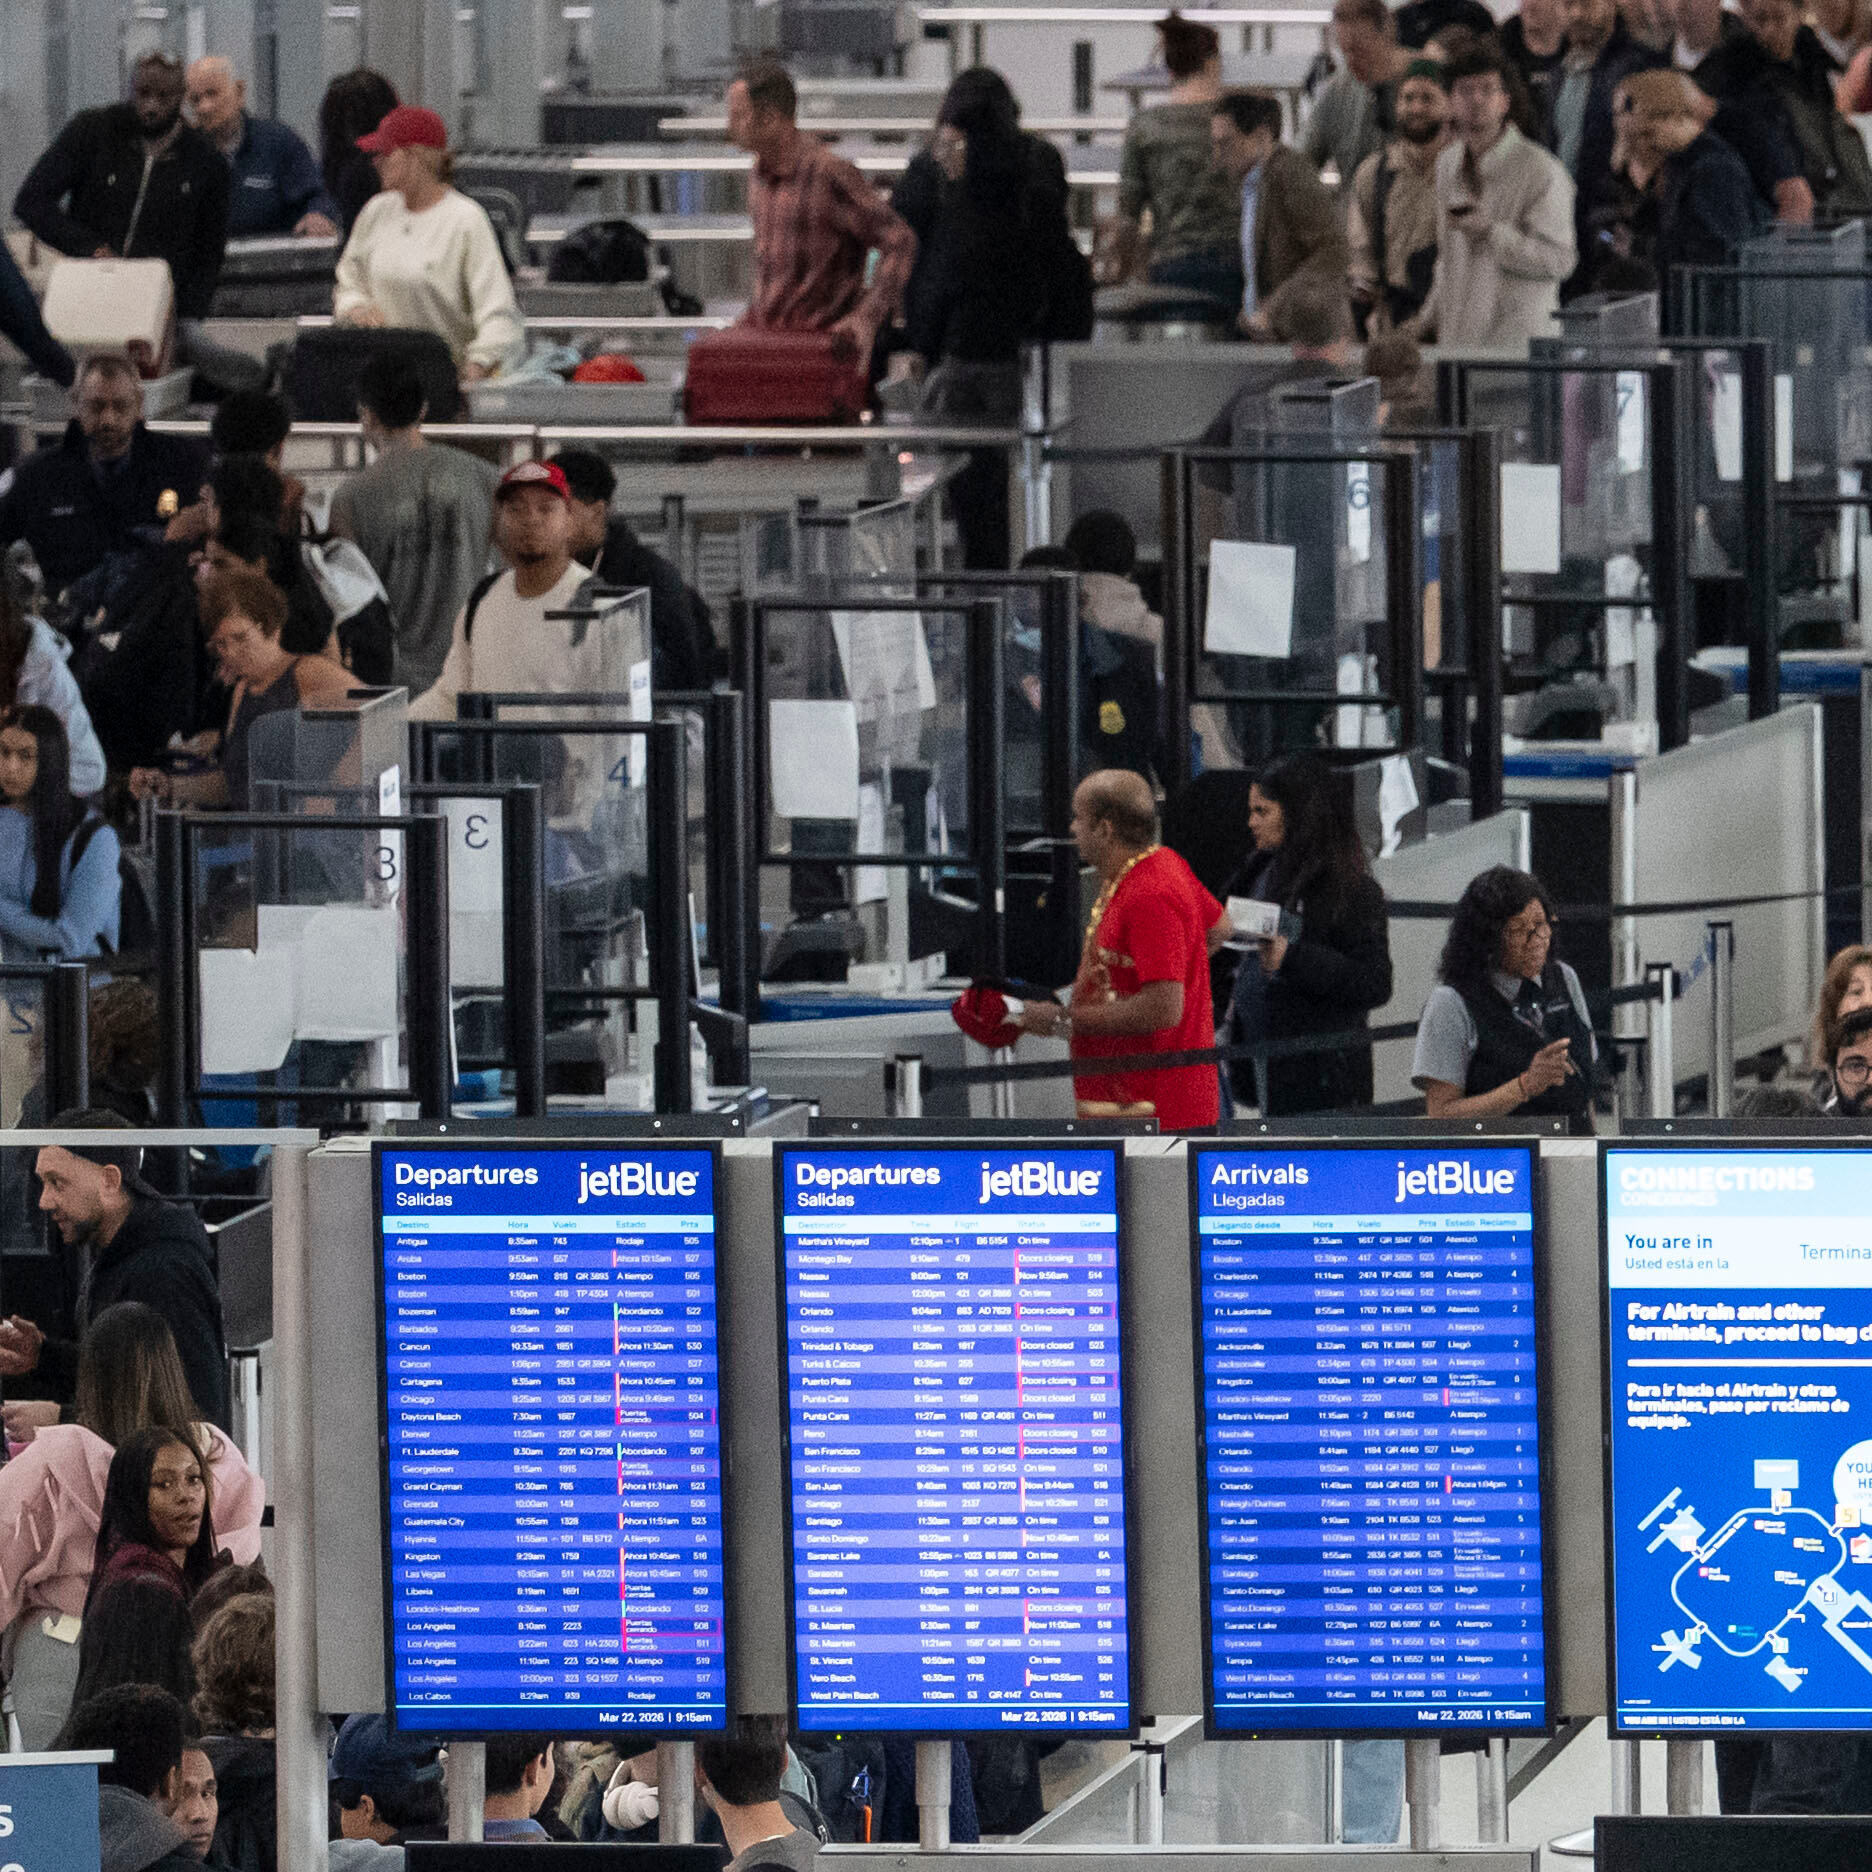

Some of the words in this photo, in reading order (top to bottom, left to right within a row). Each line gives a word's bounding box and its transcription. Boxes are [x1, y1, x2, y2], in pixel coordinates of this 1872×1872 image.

[396, 1163, 538, 1190] Departures
[578, 1162, 699, 1203] jetBlue
[797, 1163, 940, 1190] Departures
[1212, 1164, 1308, 1184] Arrivals
[1395, 1161, 1516, 1202] jetBlue
[1621, 1167, 1814, 1193] CONNECTIONS
[979, 1162, 1099, 1204] jetBlue
[397, 1192, 452, 1206] Salidas
[798, 1192, 854, 1206] Salidas
[1214, 1193, 1285, 1210] Llegadas
[1625, 1234, 1656, 1248] You
[1662, 1238, 1690, 1248] are
[1698, 1238, 1712, 1248] in
[1625, 1258, 1662, 1269] Usted
[1667, 1259, 1693, 1269] está
[1718, 1259, 1728, 1269] la
[1627, 1303, 1660, 1321] For
[1662, 1303, 1734, 1321] Airtrain
[1737, 1303, 1771, 1321] and
[1774, 1303, 1825, 1321] other
[1628, 1324, 1723, 1344] terminals,
[1725, 1325, 1800, 1344] proceed
[1802, 1326, 1821, 1341] to
[1823, 1324, 1857, 1344] bag
[1848, 1463, 1872, 1473] YOU
[600, 1713, 619, 1722] Mar
[622, 1713, 637, 1723] 22,
[639, 1713, 664, 1722] 2026
[676, 1713, 712, 1722] 9:15am
[1002, 1712, 1022, 1721] Mar
[1024, 1711, 1040, 1723] 22,
[1041, 1711, 1067, 1721] 2026
[1078, 1711, 1115, 1721] 9:15am
[1418, 1711, 1438, 1720] Mar
[1441, 1711, 1456, 1721] 22,
[1458, 1710, 1483, 1720] 2026
[1495, 1710, 1531, 1719] 9:15am
